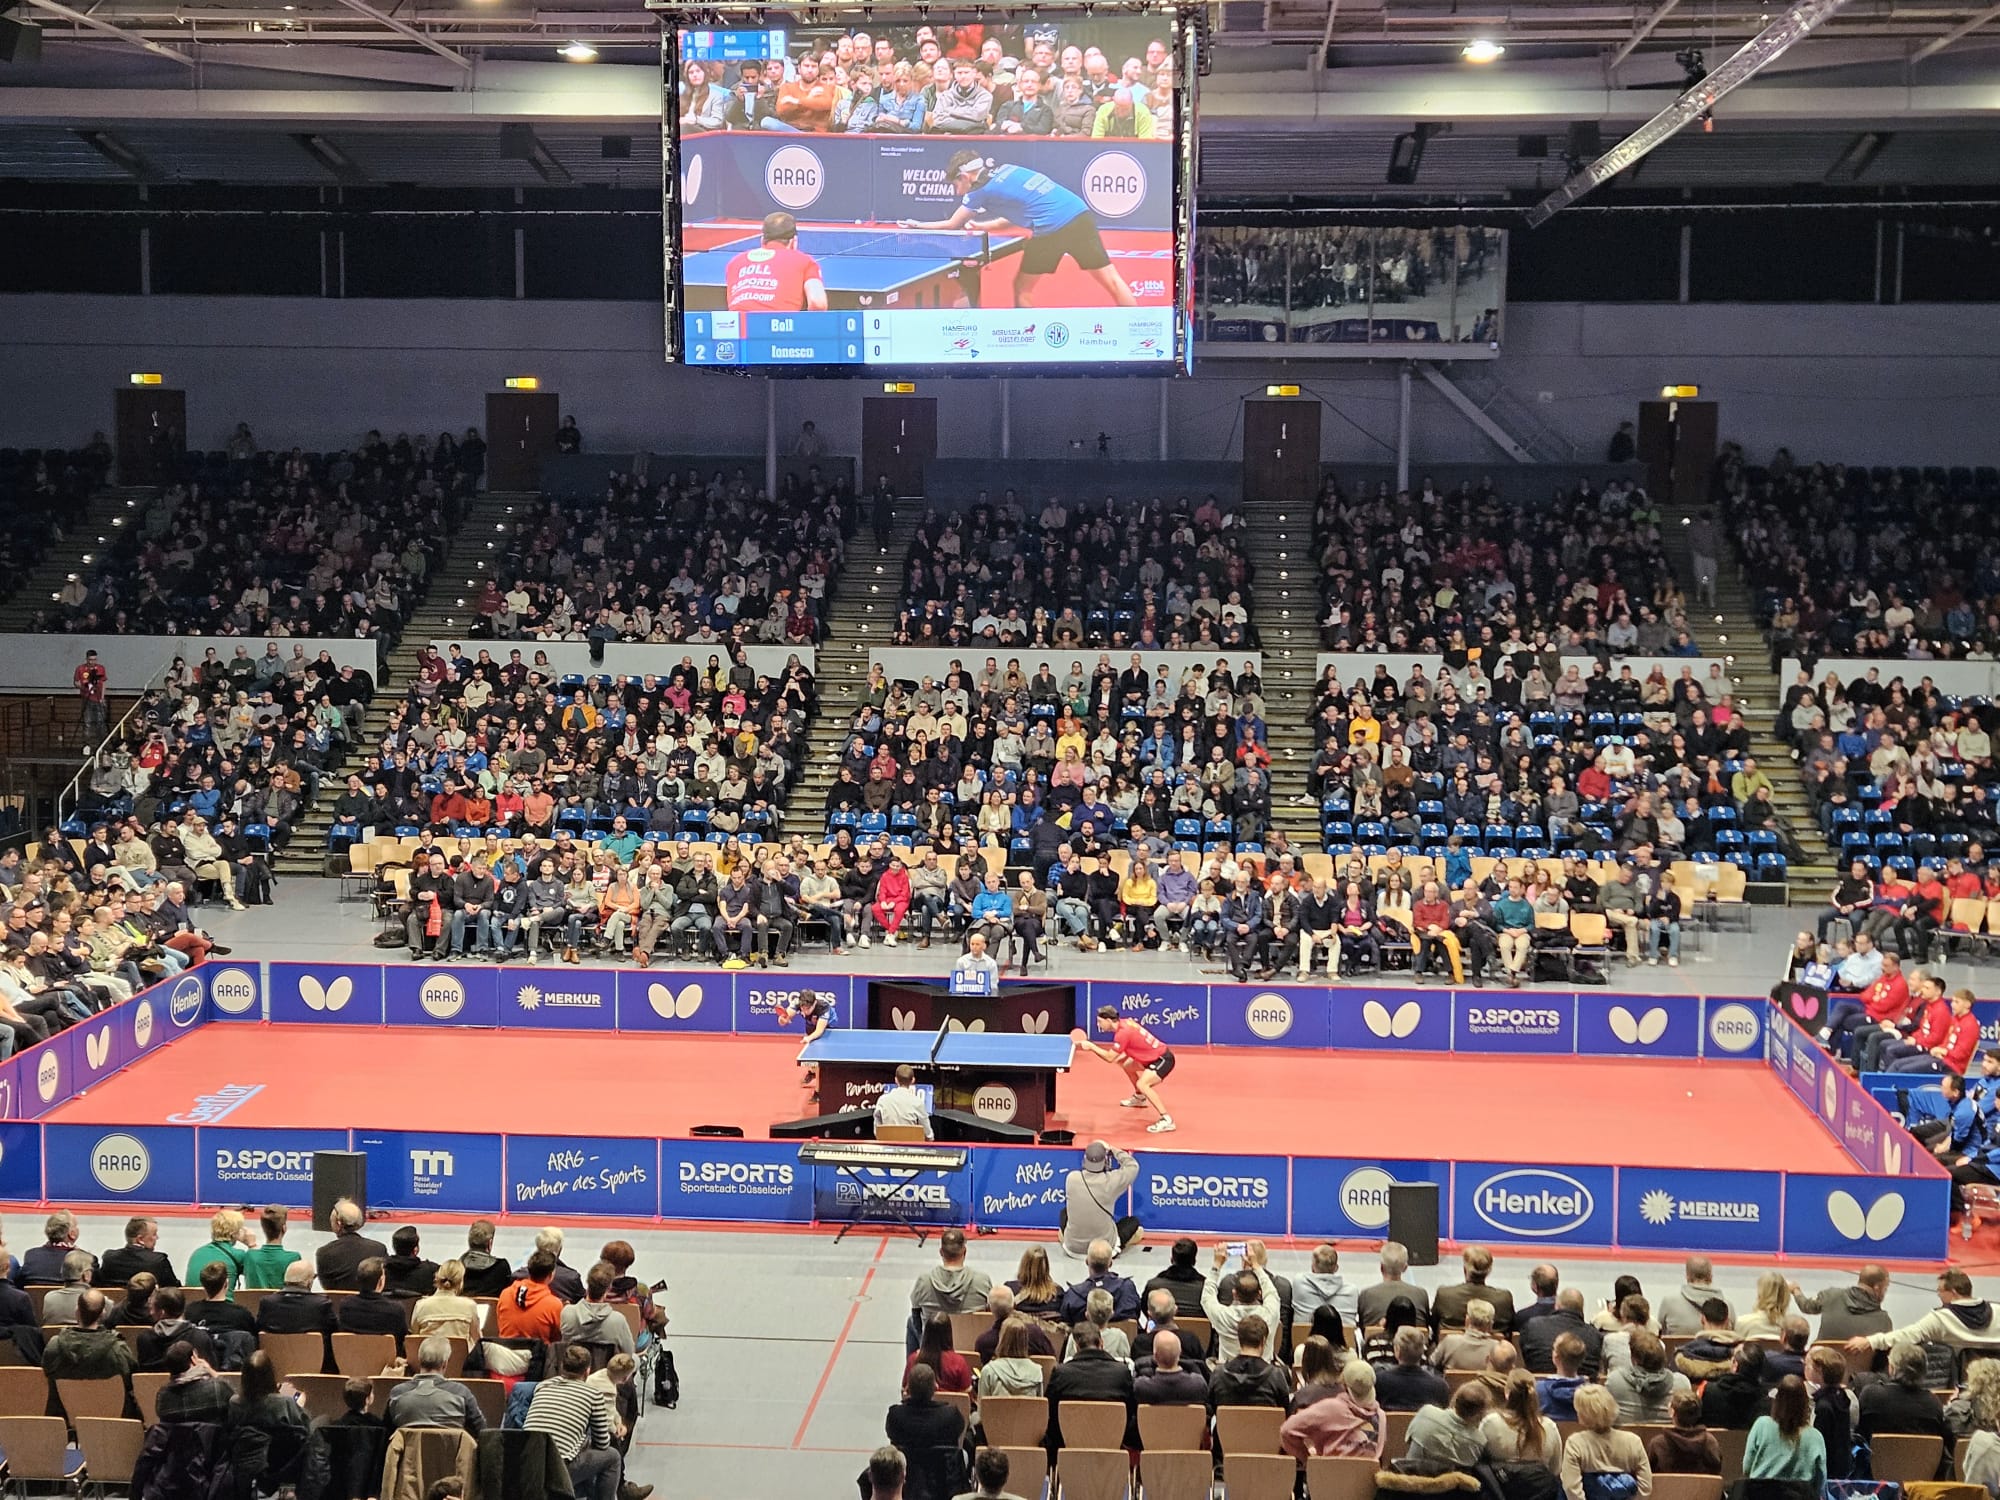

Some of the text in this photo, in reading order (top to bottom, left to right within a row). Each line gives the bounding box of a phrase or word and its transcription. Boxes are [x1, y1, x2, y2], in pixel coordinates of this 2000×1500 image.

[773, 167, 816, 186] ARAG
[903, 169, 947, 182] WELCOM
[902, 182, 955, 195] TO CHINA
[1091, 175, 1138, 194] ARAG
[695, 318, 704, 333] 1
[770, 318, 794, 332] Boll
[846, 318, 856, 332] 0
[873, 318, 880, 330] 0
[1079, 338, 1118, 347] Hamburg
[695, 344, 706, 361] 2
[771, 344, 815, 359] Ionescu
[847, 344, 856, 358] 0
[874, 344, 881, 357] 0
[955, 971, 964, 984] 0
[976, 971, 985, 985] 0
[217, 984, 250, 997] ARAG
[426, 989, 459, 1003] ARAG
[544, 992, 601, 1005] MERKUR
[173, 986, 200, 1016] Henkel
[1122, 993, 1151, 1010] ARAG
[1140, 1005, 1200, 1029] des Sports
[1252, 1009, 1286, 1023] ARAG
[1469, 1008, 1560, 1026] D.SPORTS
[1717, 1021, 1753, 1036] ARAG
[845, 1080, 887, 1097] Partner
[978, 1097, 1012, 1111] ARAG
[99, 1155, 141, 1171] ARAG
[217, 1150, 314, 1170] D.SPORT
[547, 1150, 584, 1171] ARAG
[218, 1170, 313, 1182] Sportstadt Düsseld
[679, 1162, 793, 1184] D.SPORTS
[1016, 1162, 1053, 1184] ARAG
[516, 1165, 647, 1201] Partner des Sports
[680, 1182, 793, 1195] Sportstadt Düsseldorf
[1151, 1174, 1268, 1198] D.SPORTS
[983, 1187, 1065, 1214] Partner des
[1152, 1195, 1268, 1208] Sportstadt Düsseldorf
[1486, 1188, 1581, 1216] Henkel
[1679, 1200, 1760, 1218] MERKUR
